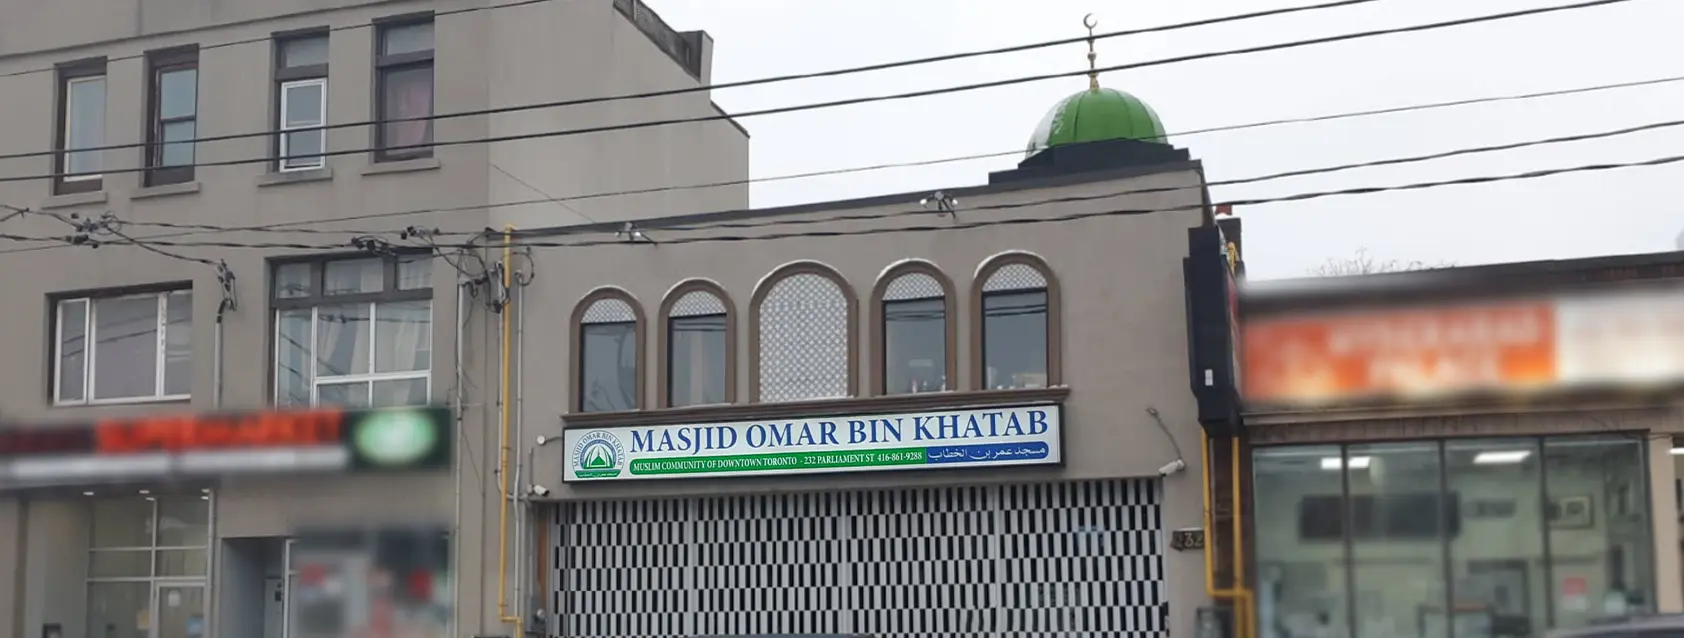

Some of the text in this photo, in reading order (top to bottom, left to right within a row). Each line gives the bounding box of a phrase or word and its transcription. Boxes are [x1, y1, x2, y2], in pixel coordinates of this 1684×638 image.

[582, 432, 600, 444] OMAR
[630, 410, 1048, 455] MASJID OMAR BIN KHATAB
[992, 449, 1012, 460] عمر
[1014, 445, 1046, 457] مسجد
[633, 462, 660, 471] MUSLIM
[661, 460, 706, 470] COMMUNITY
[707, 460, 717, 468] OF
[718, 458, 762, 468] DOWNTOWN
[762, 456, 797, 466] TORONTO
[804, 456, 817, 465] 232
[817, 454, 865, 464] PARLIAMENT
[866, 453, 875, 462] ST
[877, 451, 922, 462] 416-861-9288
